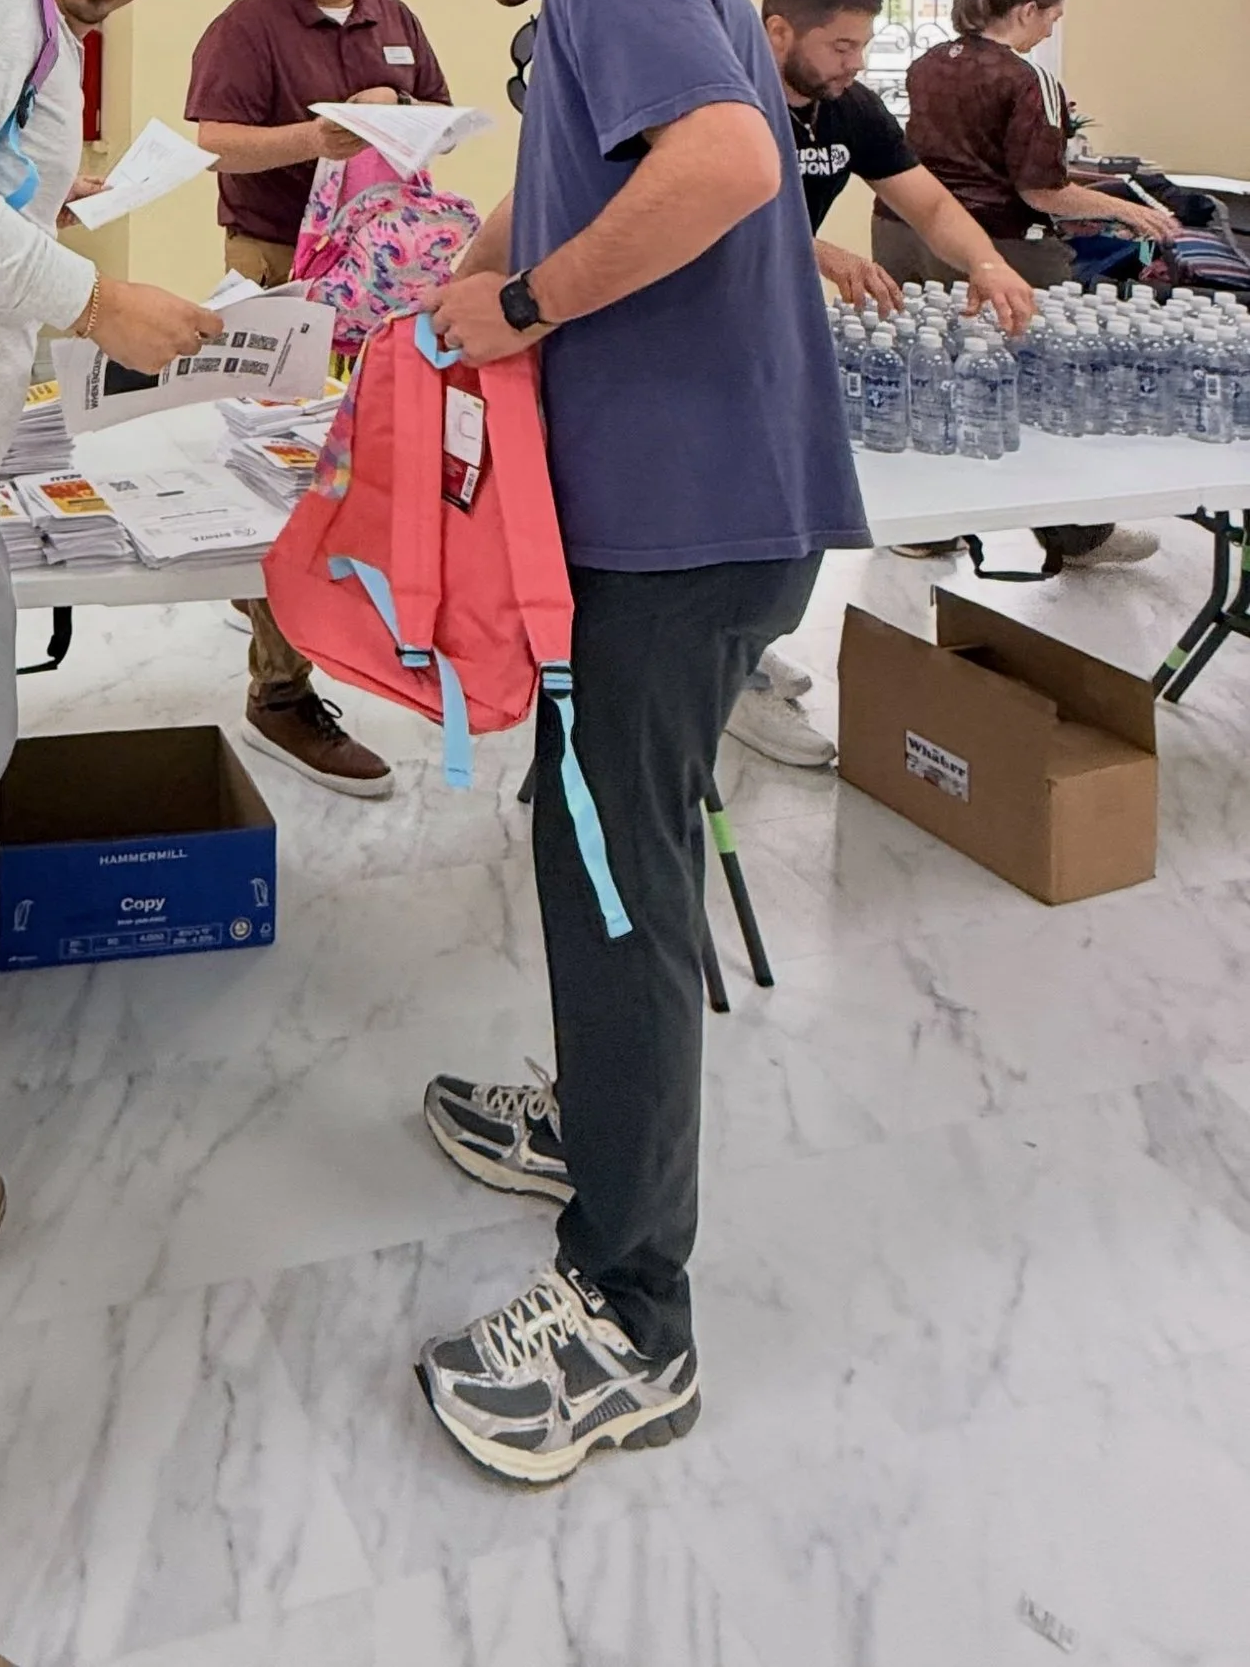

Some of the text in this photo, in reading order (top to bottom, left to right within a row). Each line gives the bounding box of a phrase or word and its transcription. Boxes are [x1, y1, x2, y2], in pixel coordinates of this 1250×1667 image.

[796, 147, 830, 163] ION
[100, 848, 188, 865] HAMMERMILL
[121, 897, 166, 913] Copy
